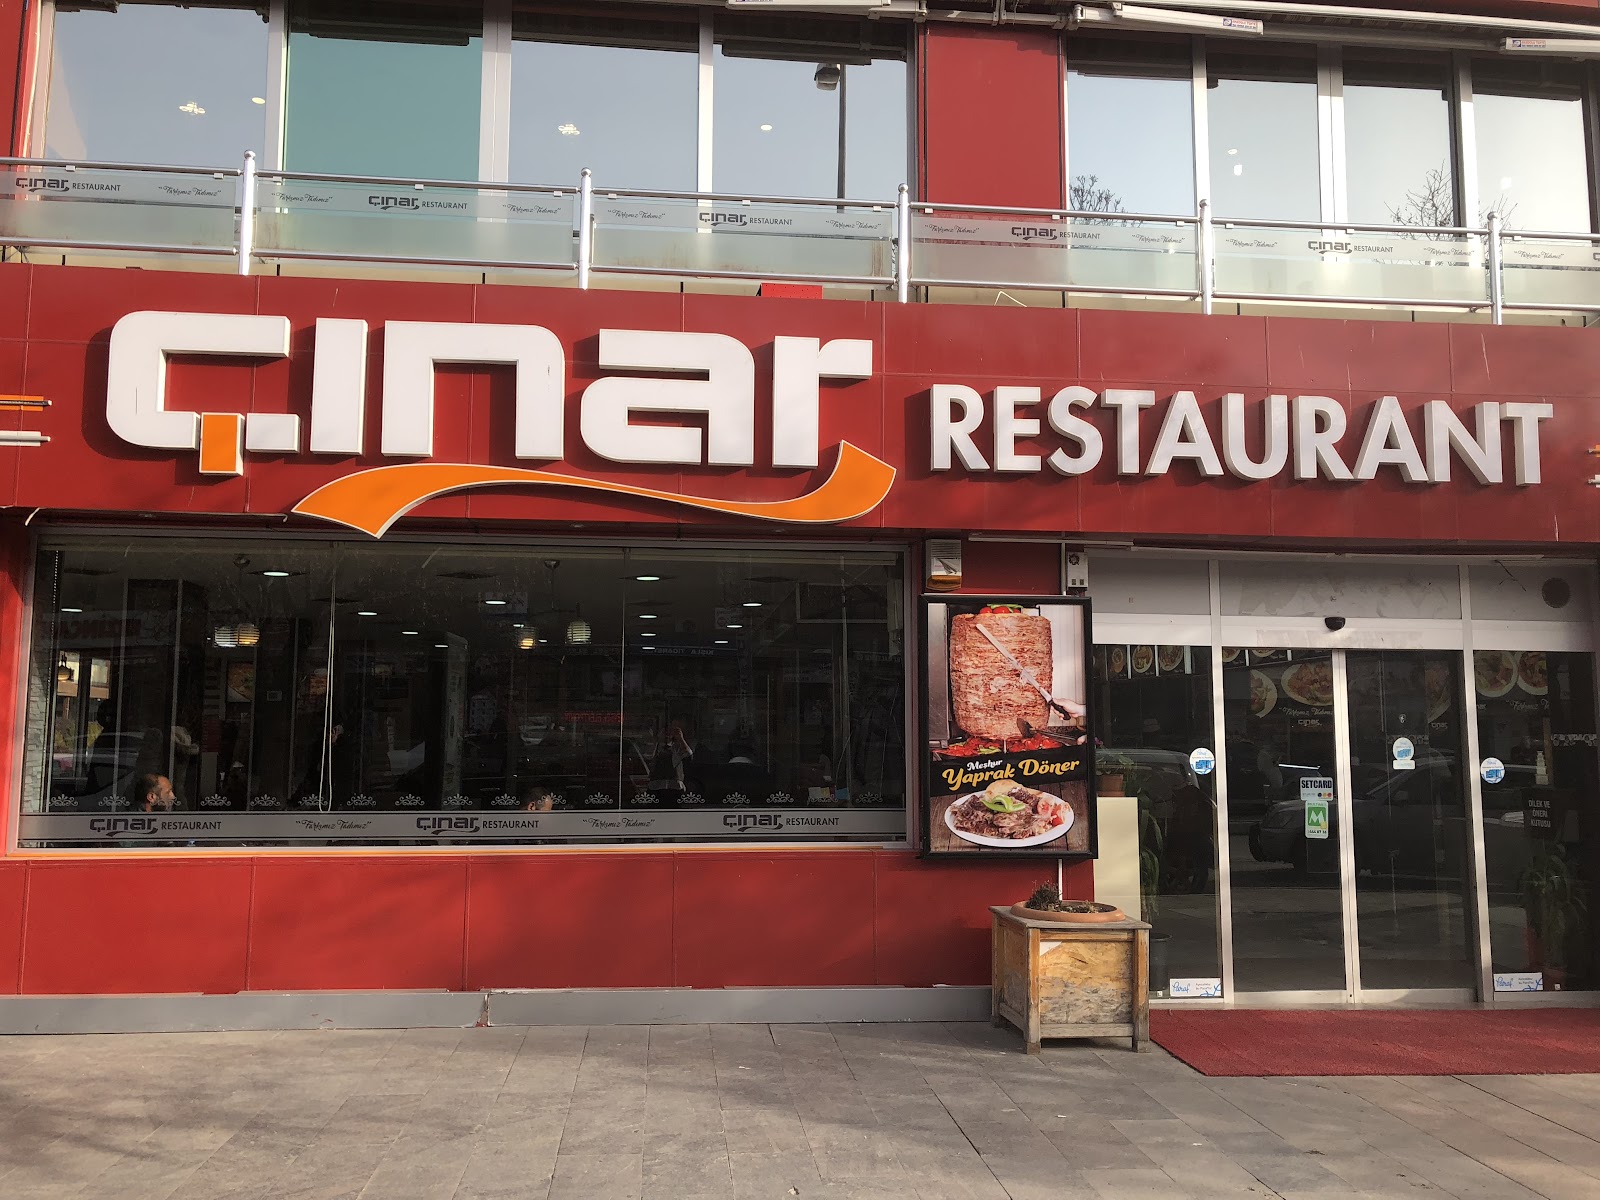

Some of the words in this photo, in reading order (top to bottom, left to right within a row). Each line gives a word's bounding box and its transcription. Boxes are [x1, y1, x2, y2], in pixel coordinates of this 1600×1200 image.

[72, 182, 122, 192] RESTAURANT
[422, 201, 468, 210] RESTAURANT
[749, 217, 793, 226] RESTAURANT
[1059, 231, 1101, 240] RESTAURANT
[1353, 245, 1394, 254] RESTAURANT
[930, 383, 1555, 487] RESTAURANT
[966, 758, 1004, 771] Meşhur
[942, 763, 1016, 792] Yaprak
[1018, 758, 1081, 776] Döner
[1302, 780, 1332, 789] SETCARD
[1544, 800, 1551, 808] VE
[160, 821, 222, 831] RESTAURANT
[482, 820, 540, 830] RESTAURANT
[786, 817, 840, 827] RESTAURANT
[1530, 819, 1551, 828] KUTUSU
